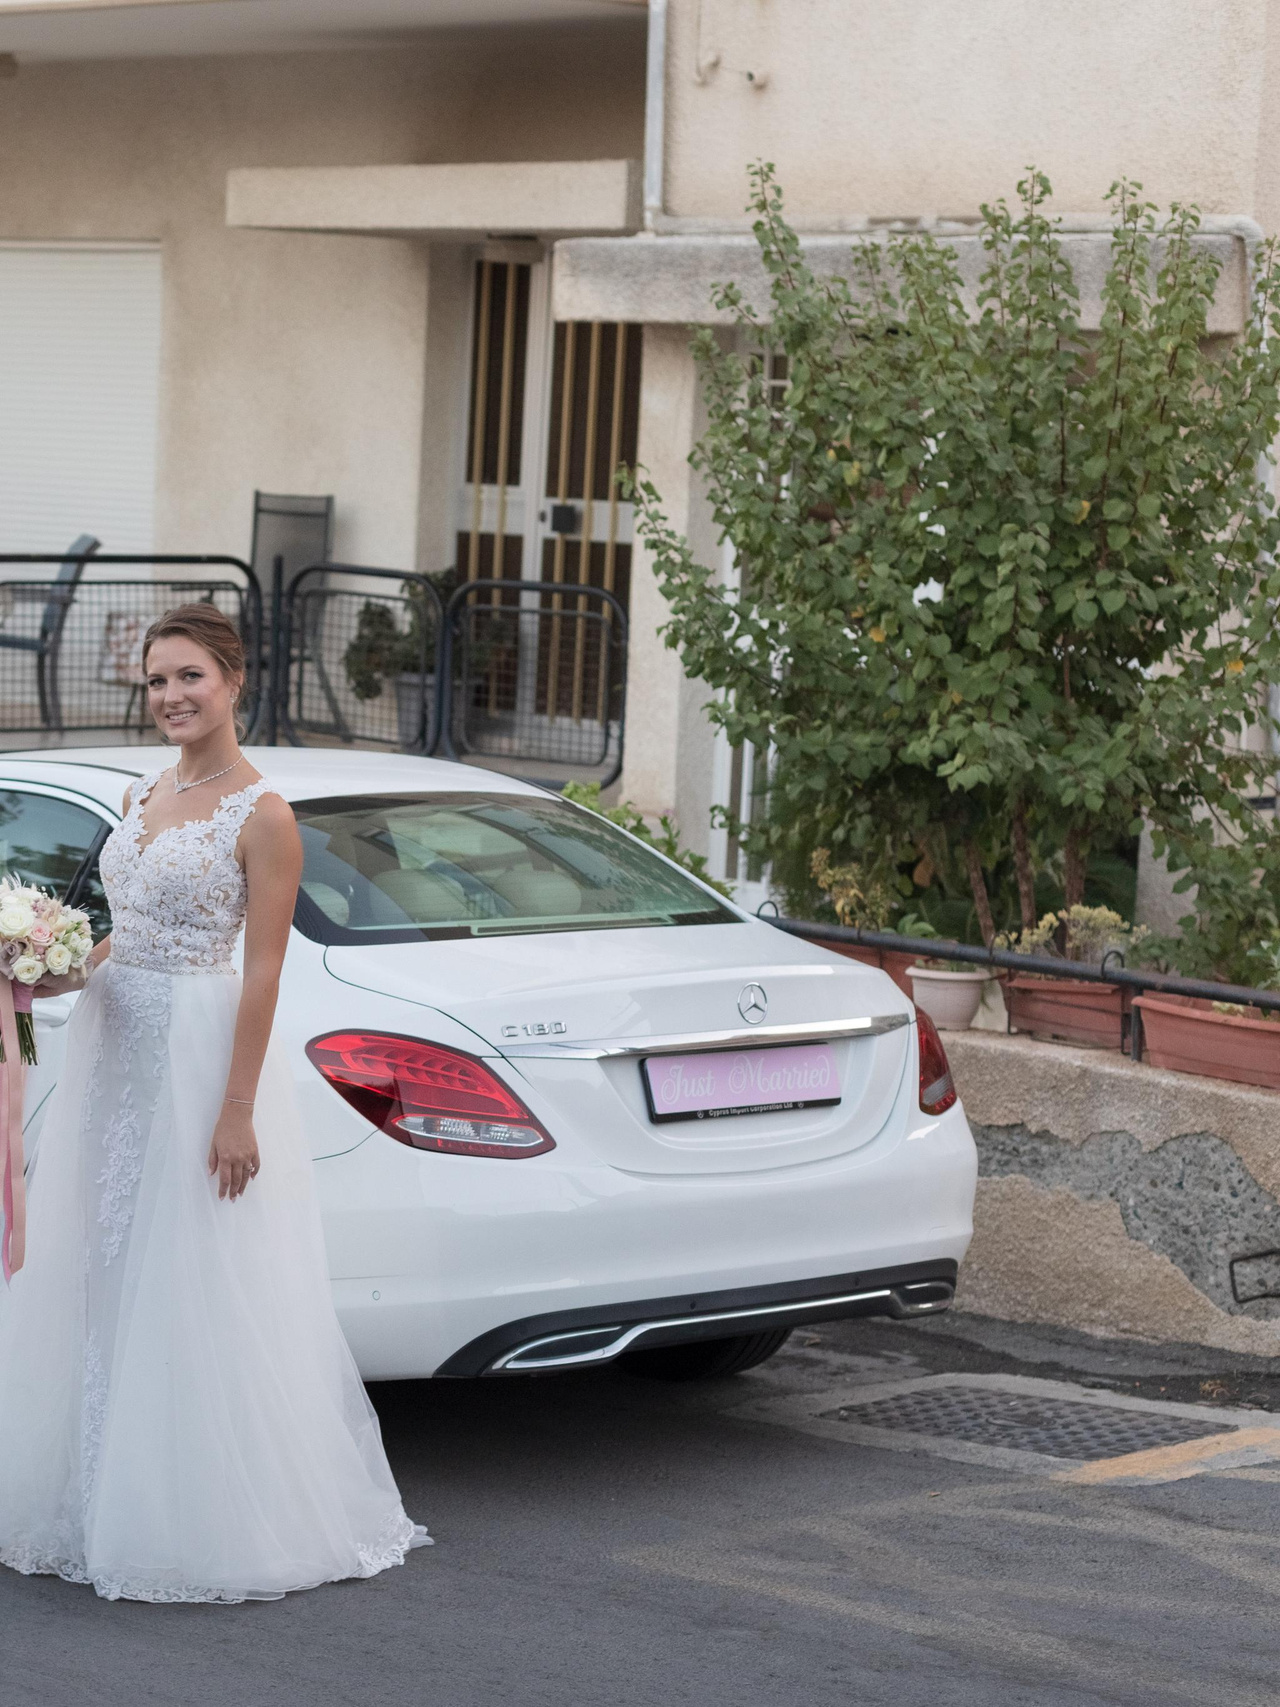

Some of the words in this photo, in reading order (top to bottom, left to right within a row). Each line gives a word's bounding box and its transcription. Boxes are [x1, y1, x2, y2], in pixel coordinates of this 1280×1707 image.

[501, 1025, 519, 1038] C
[522, 1021, 567, 1037] 180
[661, 1063, 716, 1105] Just
[728, 1054, 831, 1095] Married
[708, 1108, 730, 1118] Cyprus
[730, 1106, 750, 1115] Import
[750, 1103, 783, 1113] Corporation
